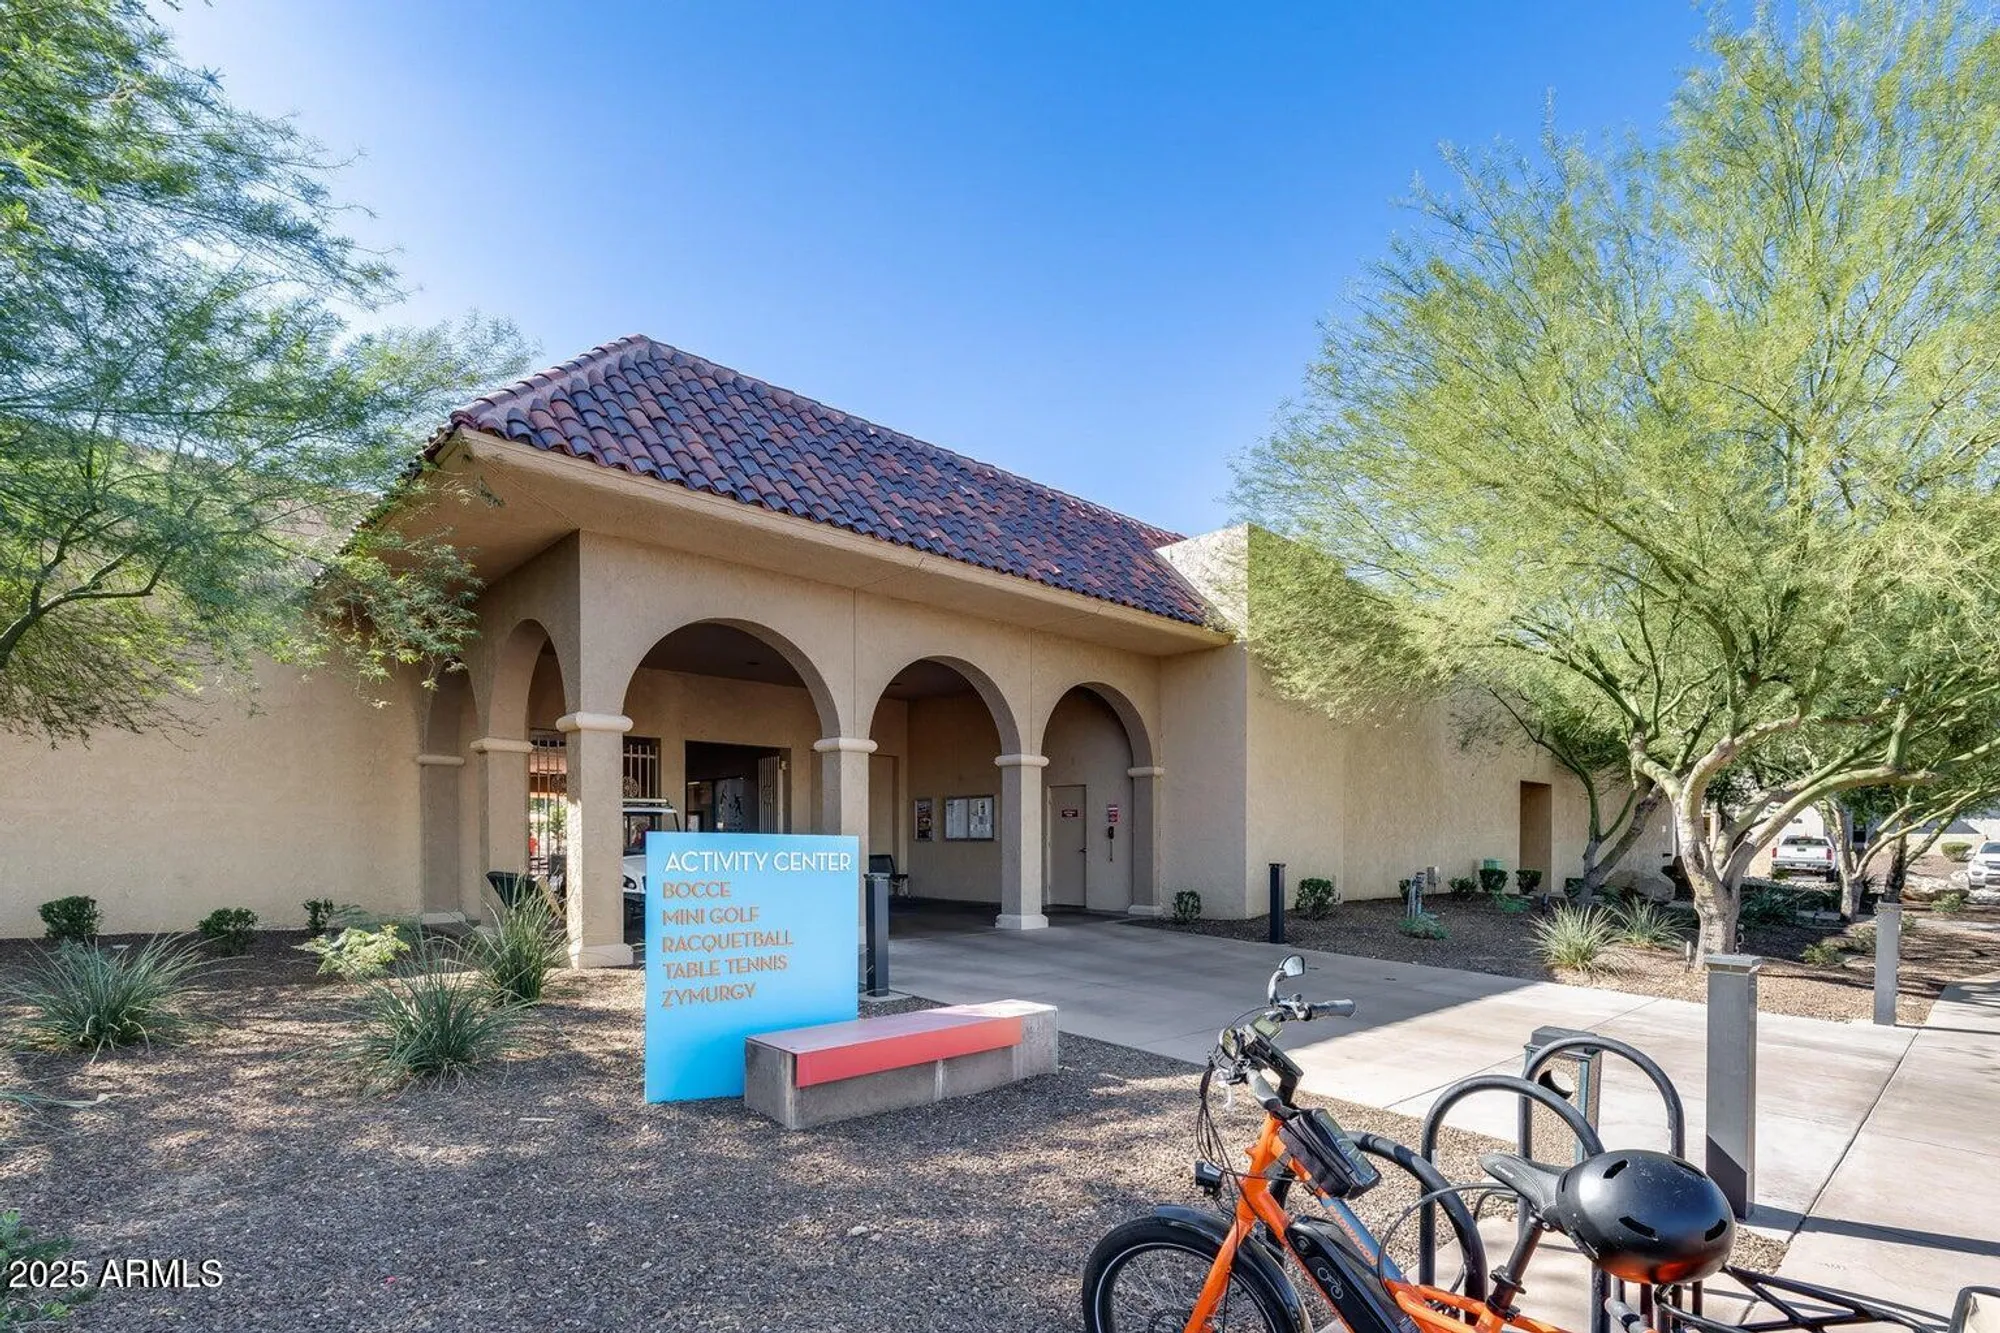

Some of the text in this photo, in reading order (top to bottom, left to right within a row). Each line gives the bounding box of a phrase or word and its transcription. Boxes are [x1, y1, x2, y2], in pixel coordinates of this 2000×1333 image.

[664, 851, 852, 872] ACTIVITY CENTER
[662, 881, 731, 899] BOCCE
[662, 906, 760, 926] MINI GOLF
[662, 930, 793, 953] RACQUETBALL
[662, 954, 788, 979] TABLE TENNIS
[661, 983, 756, 1008] ZYMURGY
